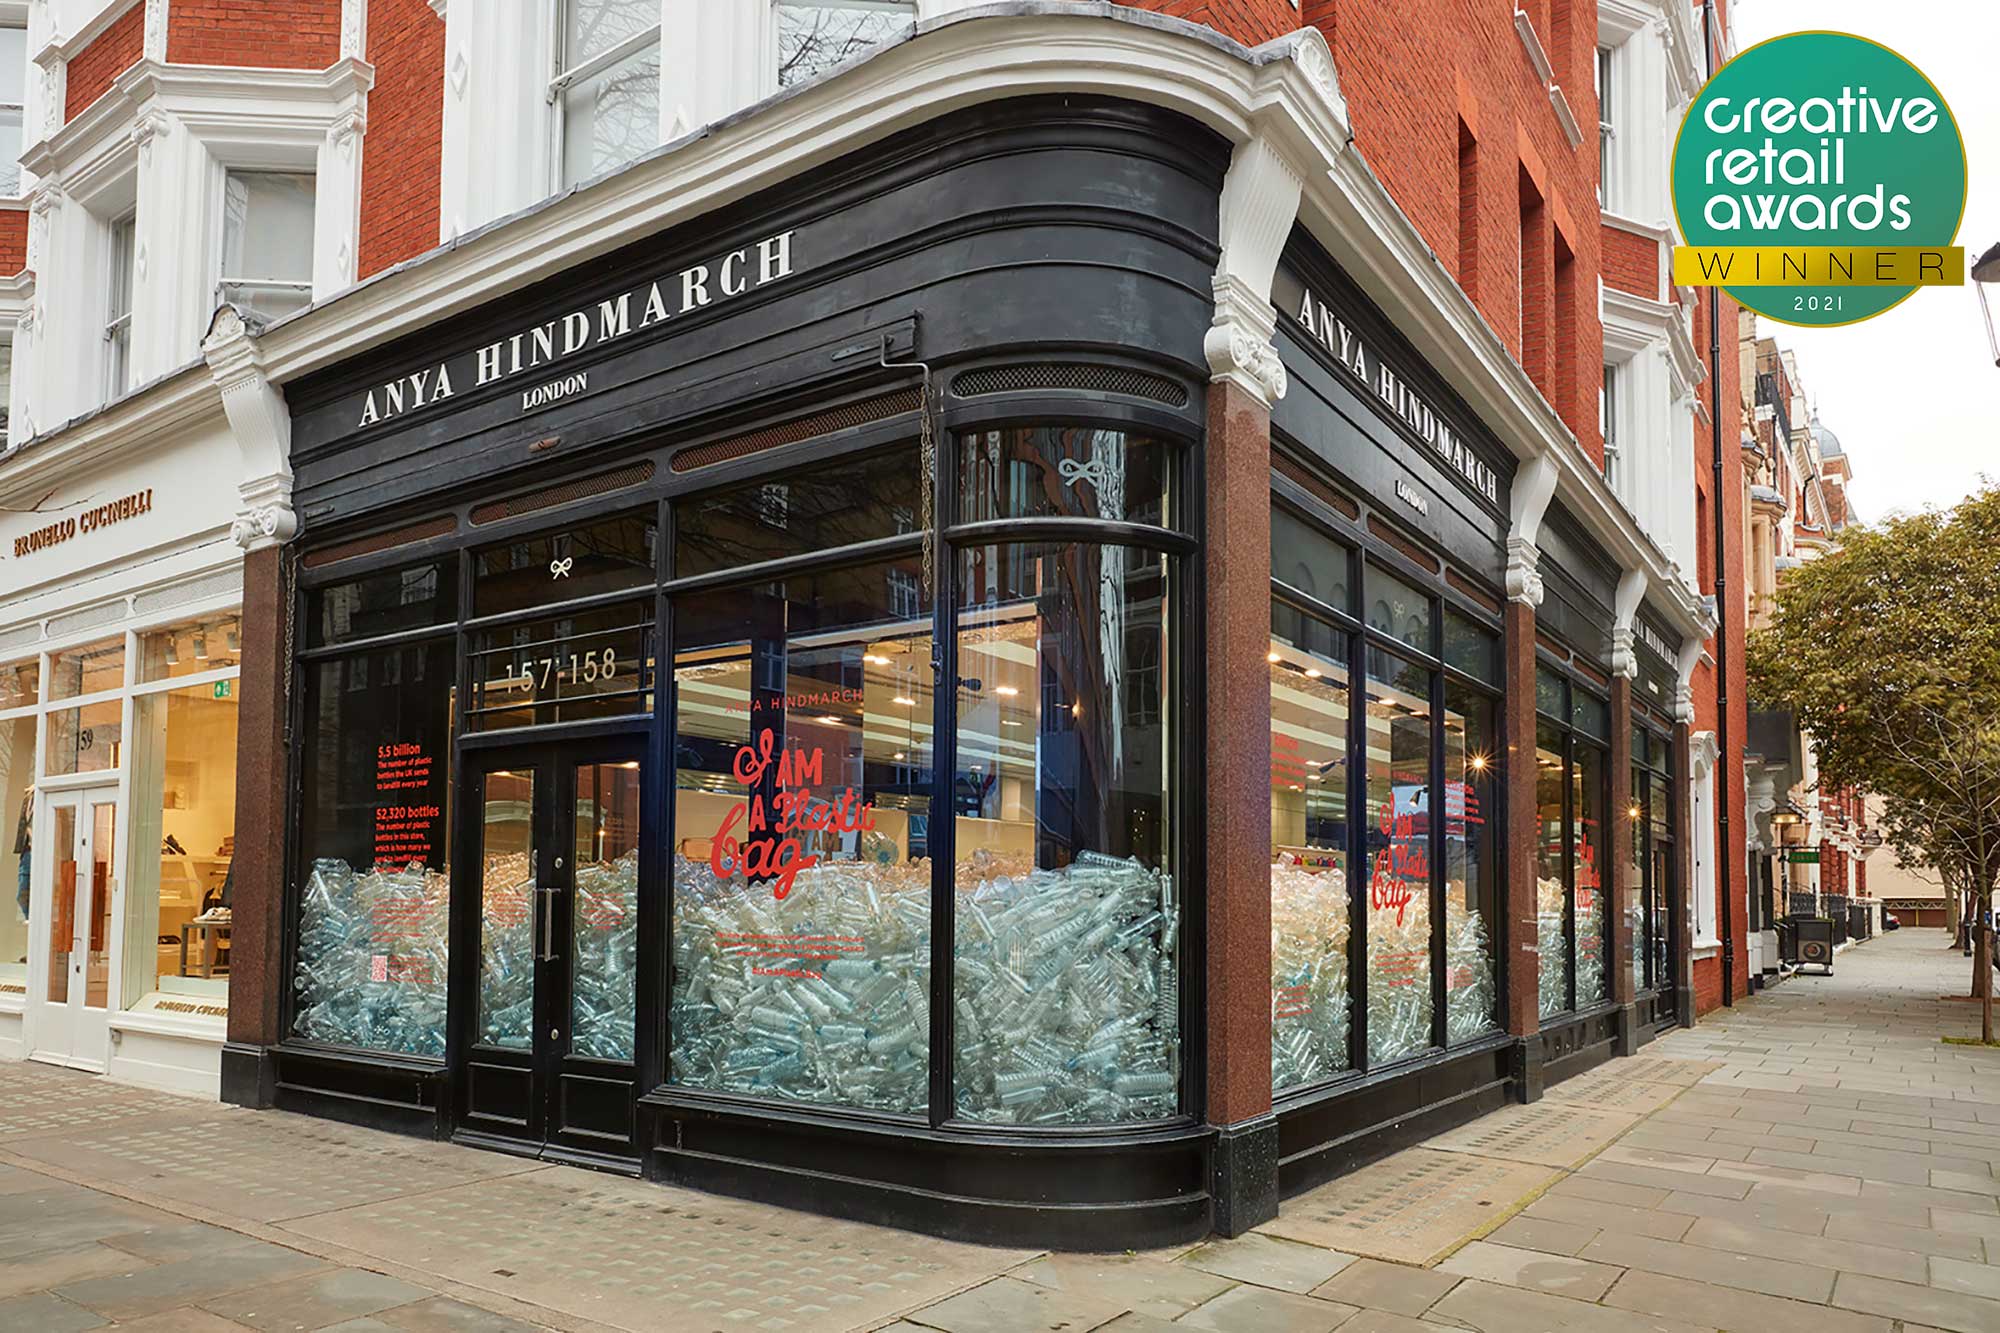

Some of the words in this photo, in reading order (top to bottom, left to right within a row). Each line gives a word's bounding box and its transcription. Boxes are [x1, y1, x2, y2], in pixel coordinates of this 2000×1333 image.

[358, 363, 454, 427] ANYA
[475, 230, 796, 386] HINDMARCH
[522, 372, 589, 412] LONDON
[1297, 288, 1370, 384] ANYA
[1379, 362, 1498, 504] HINDMARCH
[1395, 480, 1428, 516] LONDON
[14, 517, 76, 557] BRUNELLO
[80, 489, 153, 534] CUCINELLI
[771, 688, 863, 709] HINDMARCH
[378, 745, 391, 758] 5.5
[393, 743, 421, 757] billion
[775, 748, 823, 786] AM
[376, 806, 406, 821] 52,320
[407, 805, 439, 818] bottles
[748, 793, 767, 832] A
[773, 787, 877, 834] Plastic
[710, 802, 818, 901] bag
[1371, 848, 1412, 927] bag
